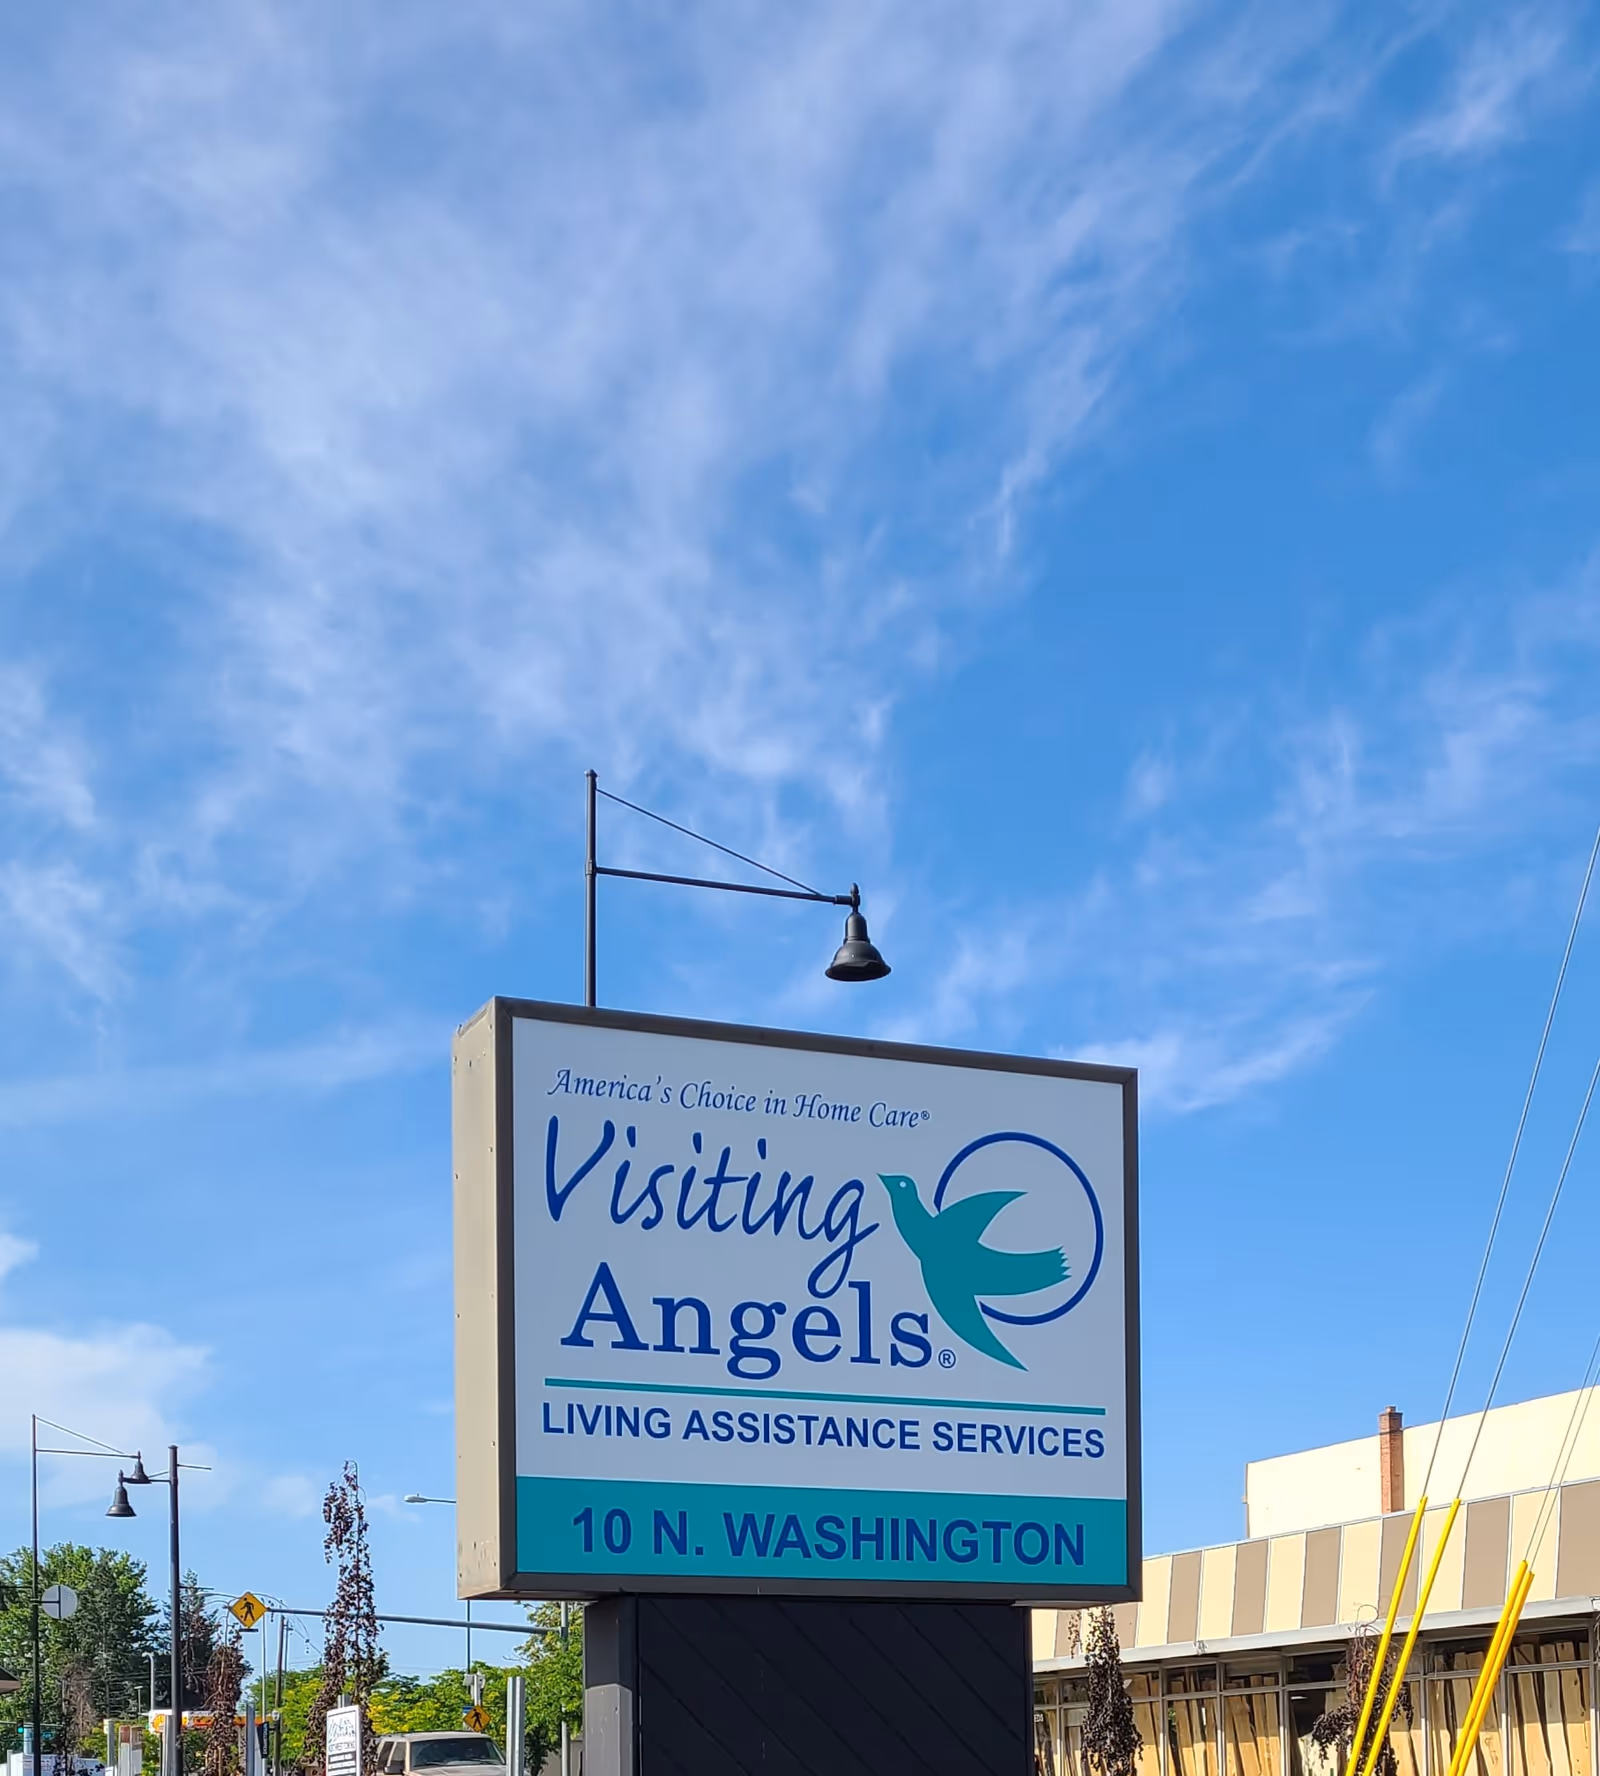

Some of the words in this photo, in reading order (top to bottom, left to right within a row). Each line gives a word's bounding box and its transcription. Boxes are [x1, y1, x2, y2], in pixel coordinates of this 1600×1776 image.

[547, 1069, 673, 1104] America's
[679, 1081, 757, 1114] Choice
[764, 1089, 788, 1115] in
[792, 1092, 863, 1123] Home
[545, 1115, 880, 1299] Visiting
[543, 1401, 672, 1439] LIVING
[682, 1409, 921, 1451] ASSISTANCE
[932, 1420, 1106, 1459] SERVICES
[572, 1506, 633, 1555] 10
[652, 1509, 706, 1558] N.
[722, 1512, 1087, 1567] WASHINGTON
